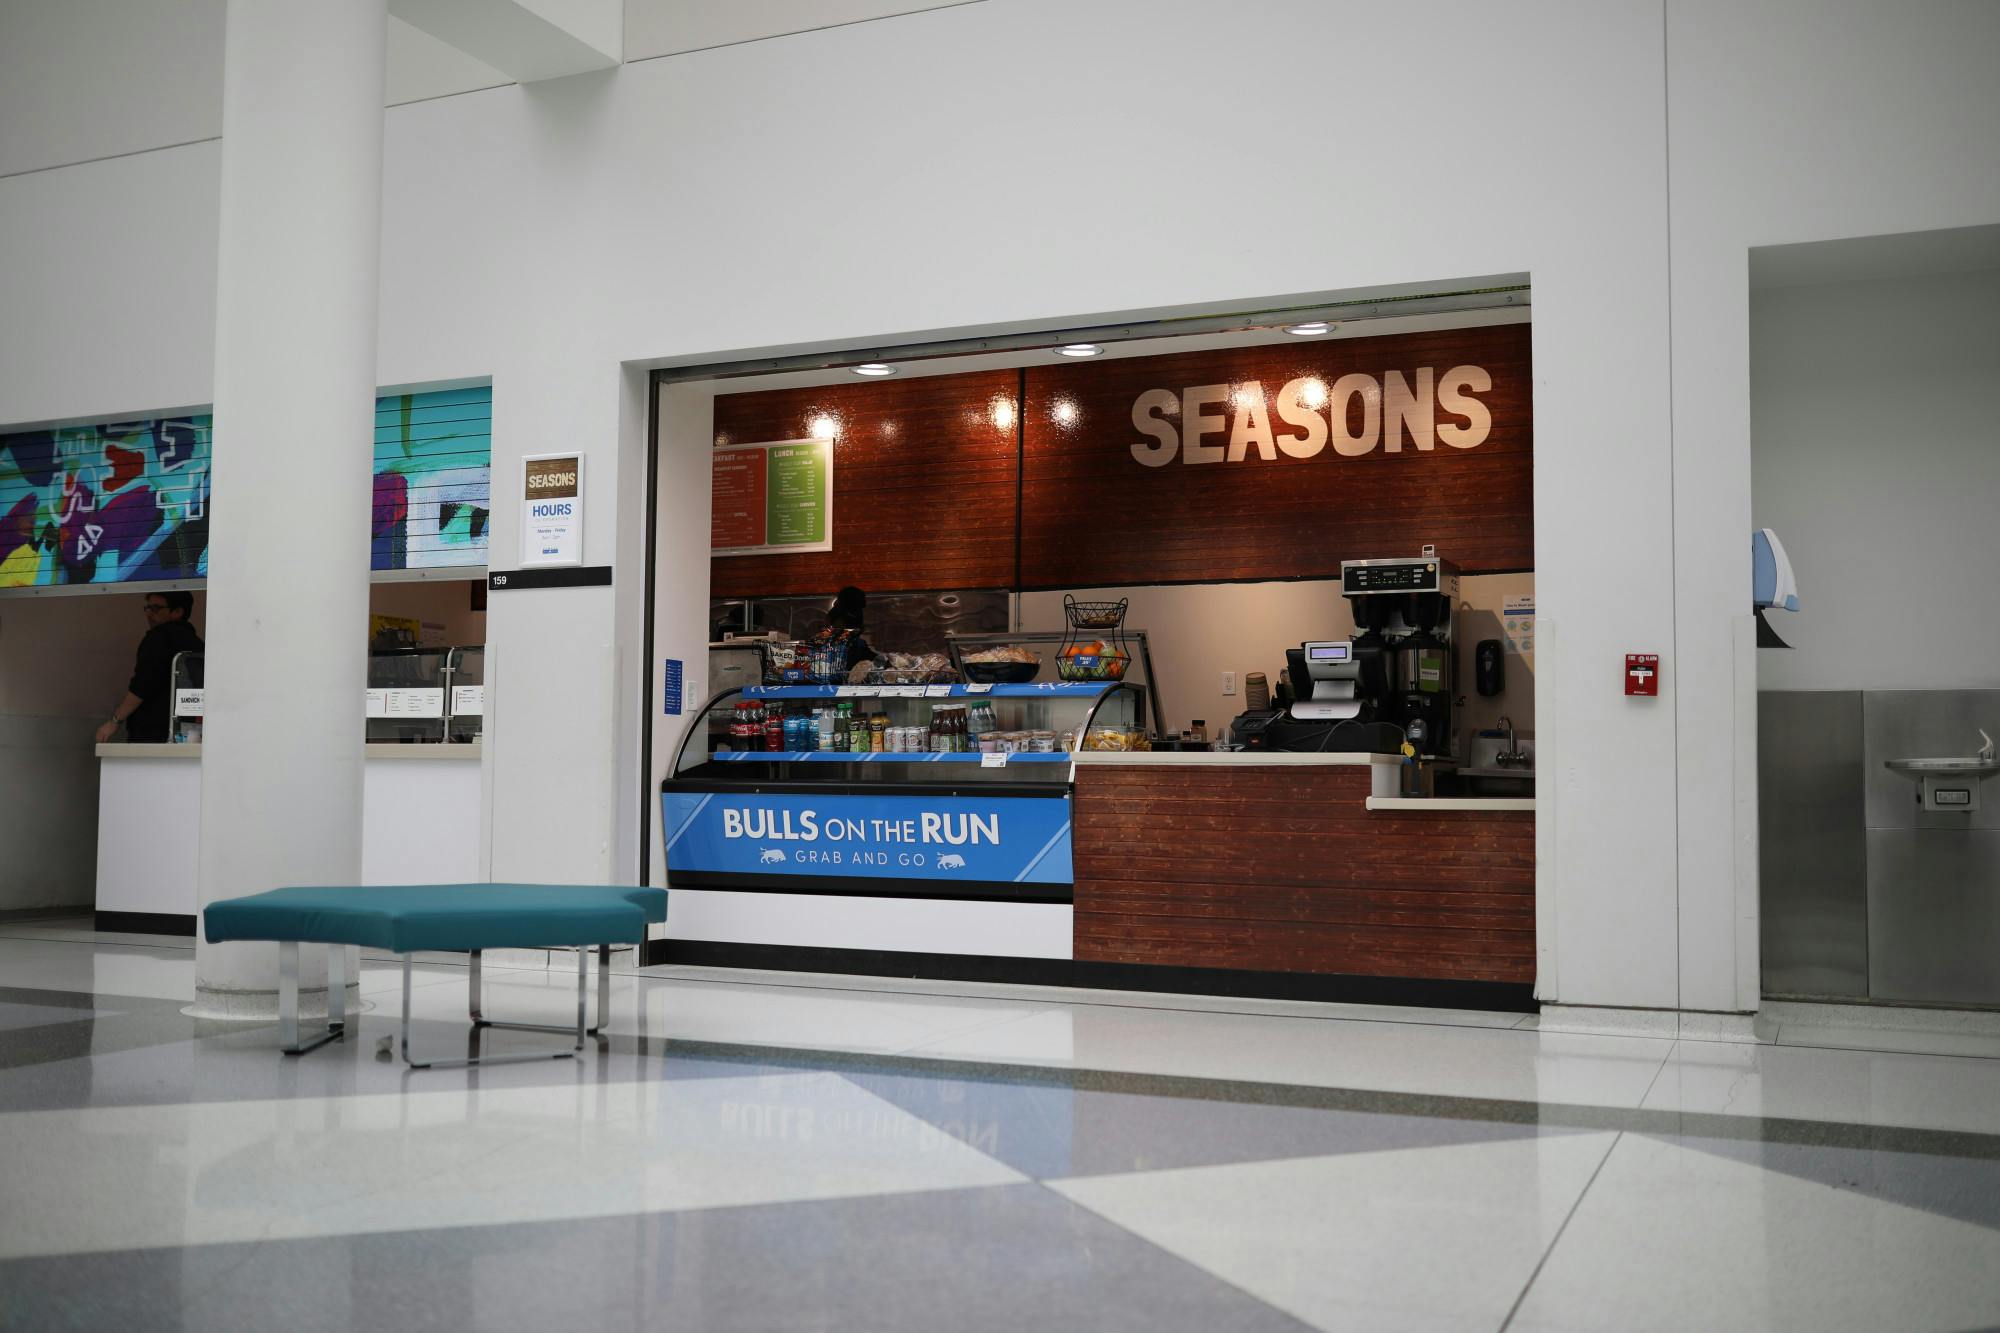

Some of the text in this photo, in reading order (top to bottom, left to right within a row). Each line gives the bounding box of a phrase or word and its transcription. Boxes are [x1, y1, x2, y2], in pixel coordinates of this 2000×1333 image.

[1130, 365, 1492, 468] SEASONS
[528, 472, 576, 489] SEASONS
[532, 503, 572, 517] HOURS
[493, 576, 507, 585] 159
[723, 808, 1000, 845] BULLS ON THE RUN
[795, 850, 925, 866] GRAB AND GO
